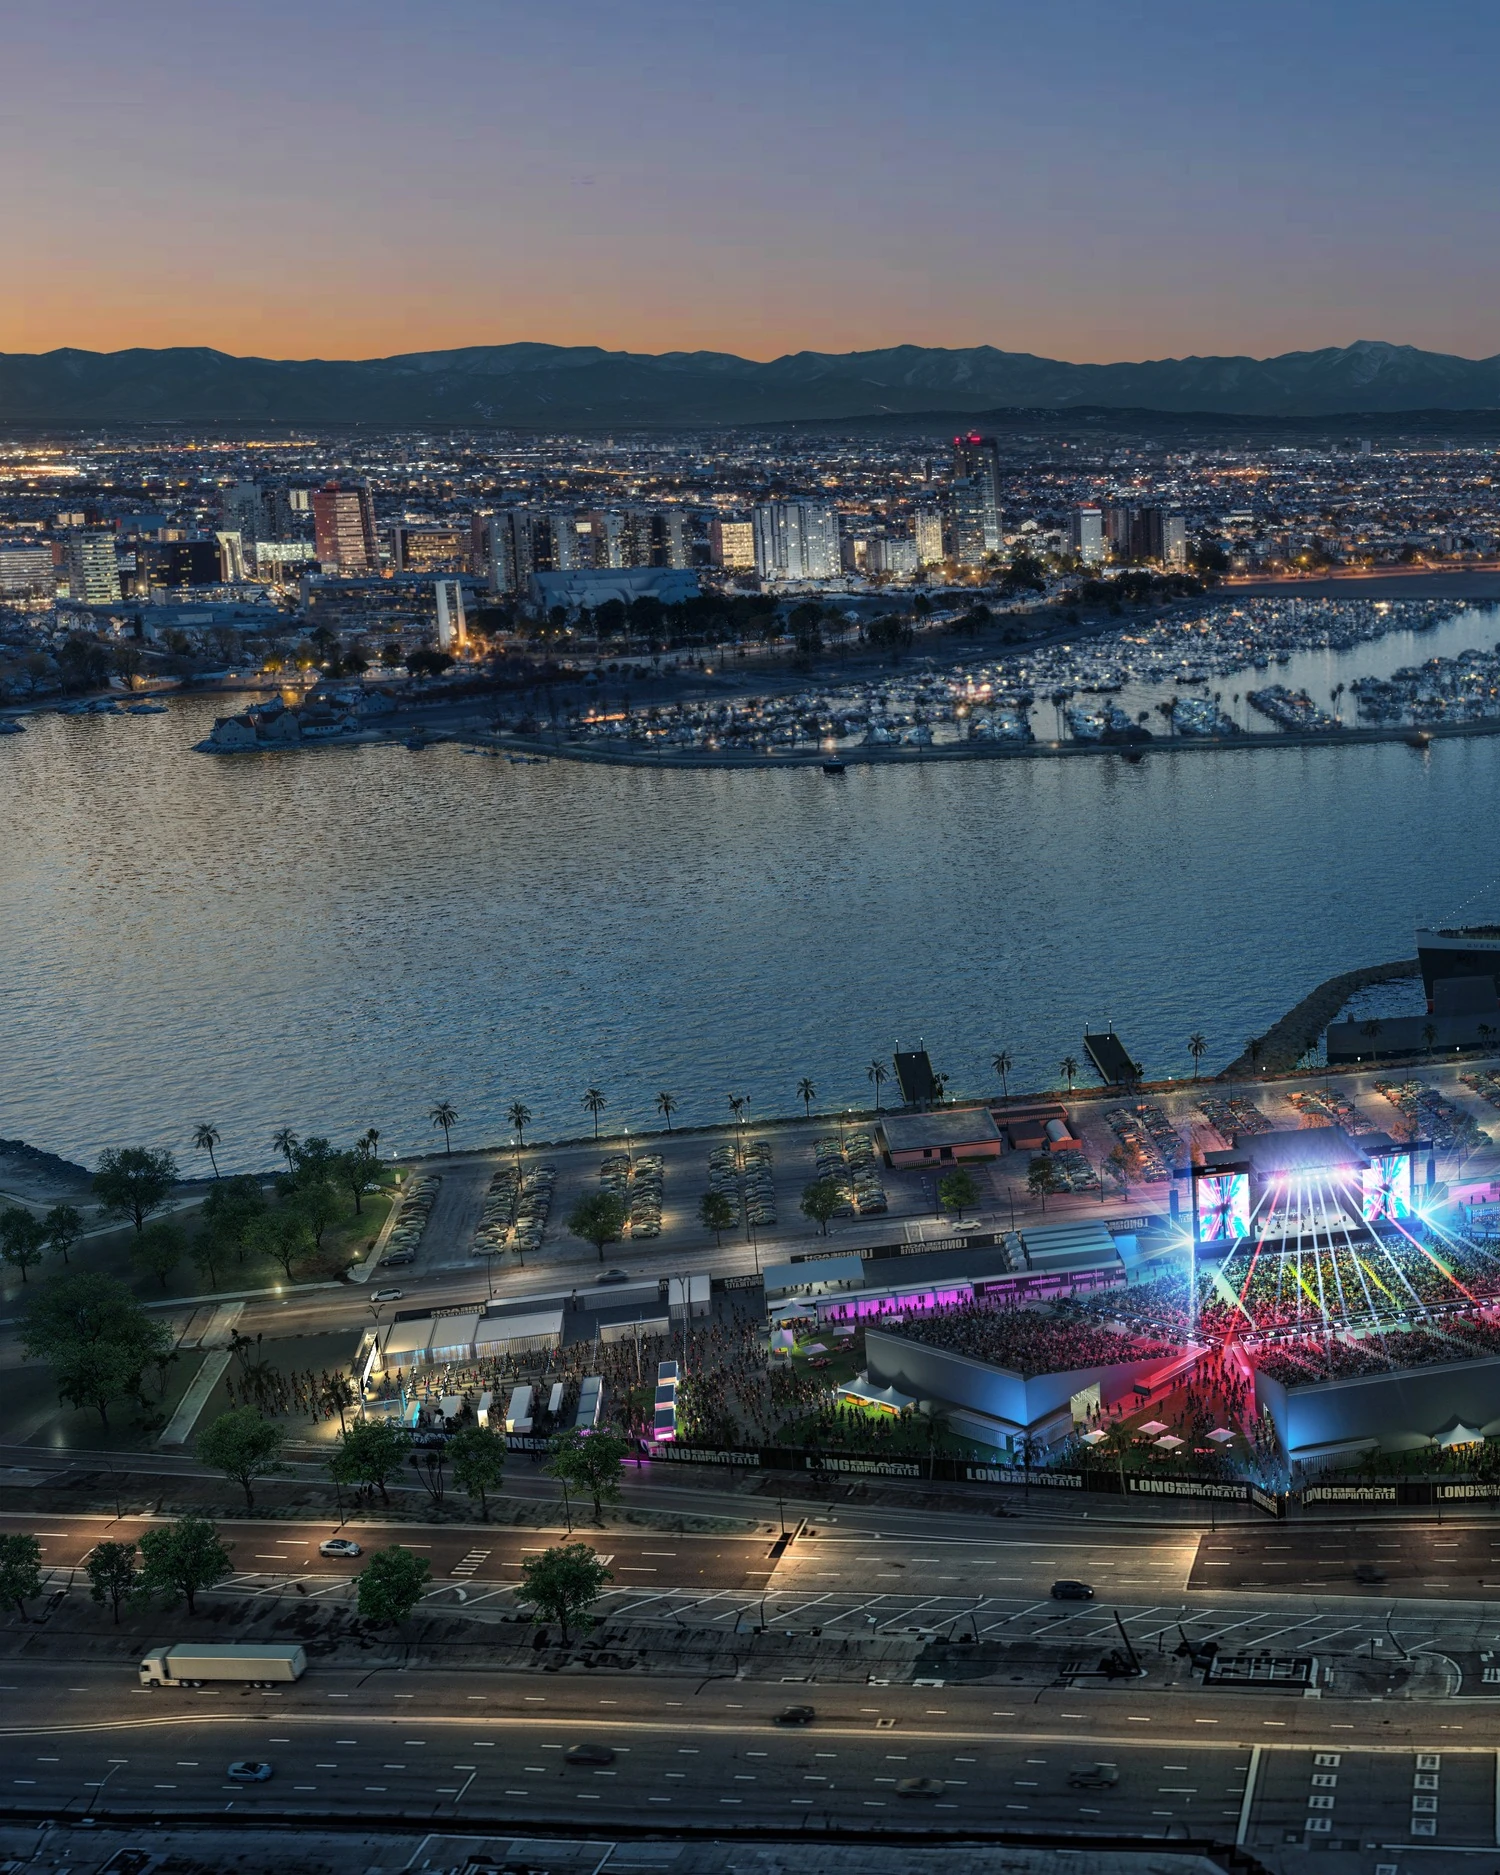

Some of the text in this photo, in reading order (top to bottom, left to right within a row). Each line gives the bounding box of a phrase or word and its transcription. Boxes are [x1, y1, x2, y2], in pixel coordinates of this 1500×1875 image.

[806, 1457, 850, 1471] LNG
[851, 1465, 919, 1476] AMPHITHEATER
[966, 1468, 1011, 1483] LONG
[1130, 1479, 1247, 1493] LONG BEACH
[1437, 1486, 1475, 1498] LONG
[1176, 1487, 1247, 1499] AMPHITHEATER
